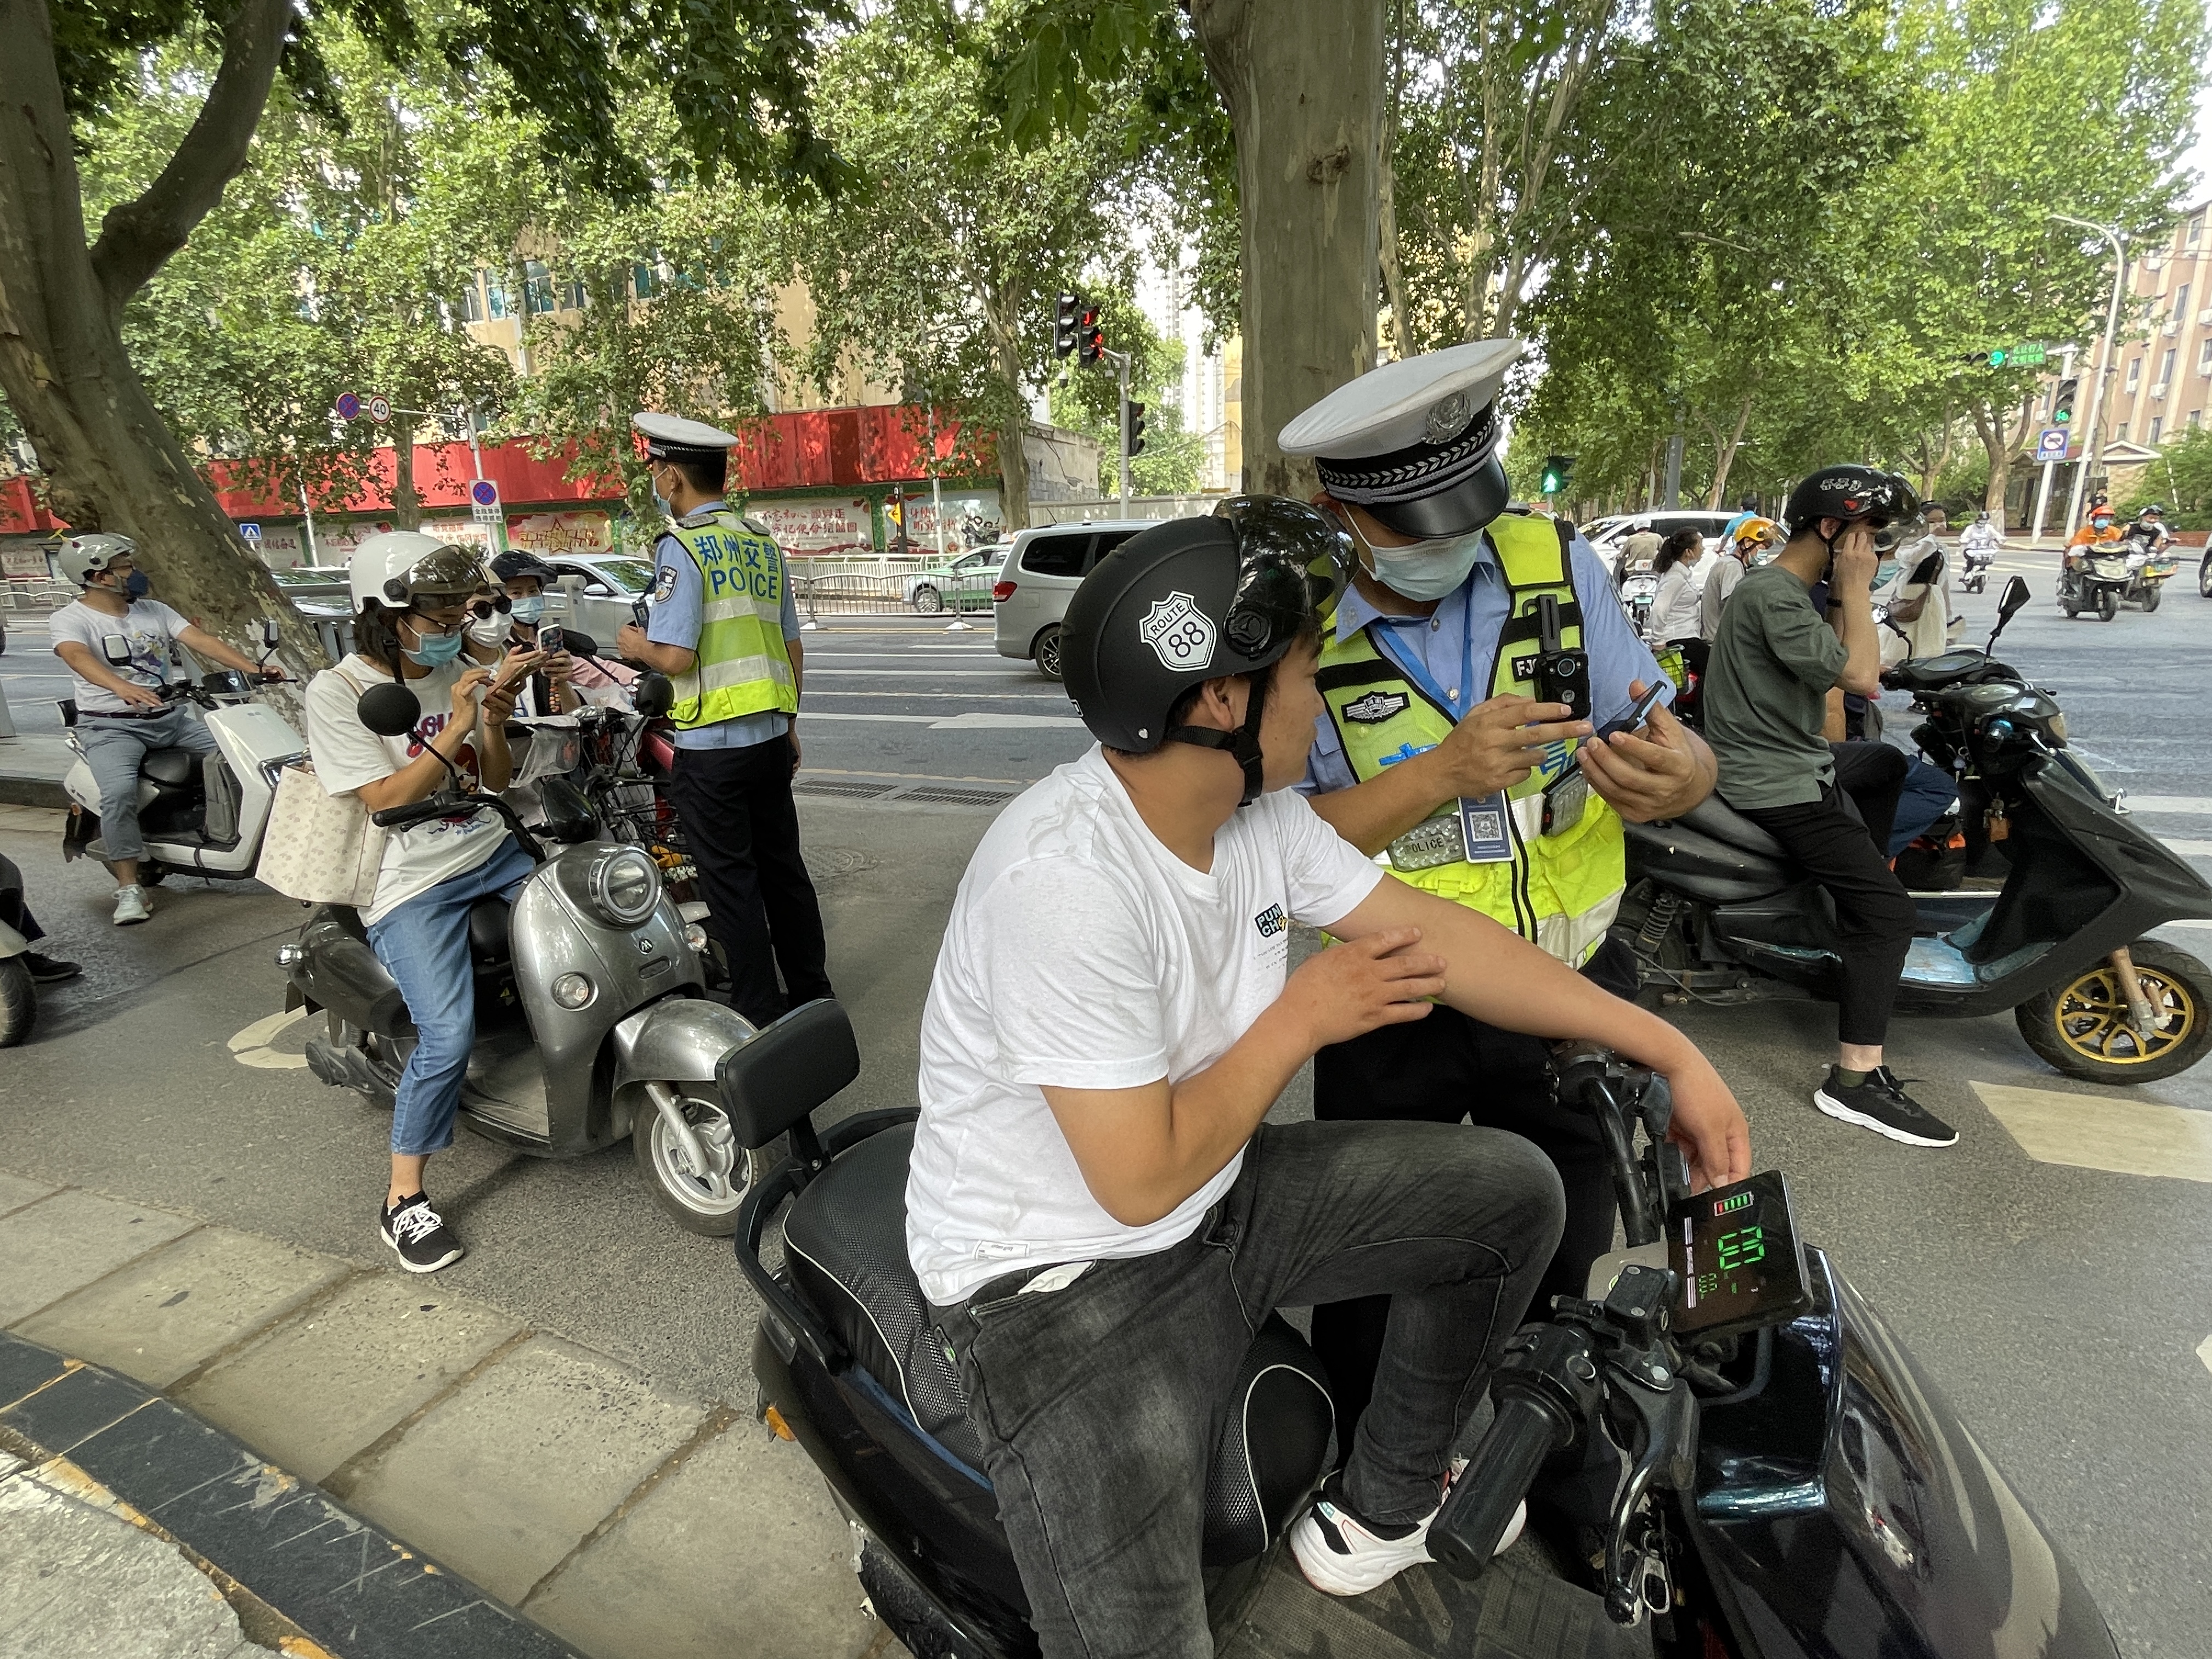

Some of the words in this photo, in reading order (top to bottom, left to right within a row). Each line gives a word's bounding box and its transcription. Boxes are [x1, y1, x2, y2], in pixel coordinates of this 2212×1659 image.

[374, 403, 386, 415] 40
[693, 533, 778, 573] 郑州交警
[710, 566, 778, 600] POICE
[1150, 602, 1186, 635] ROUTE
[1169, 621, 1205, 658] 88
[1516, 658, 1537, 676] FJ
[1405, 838, 1444, 854] POLICE
[1257, 905, 1282, 928] PUN
